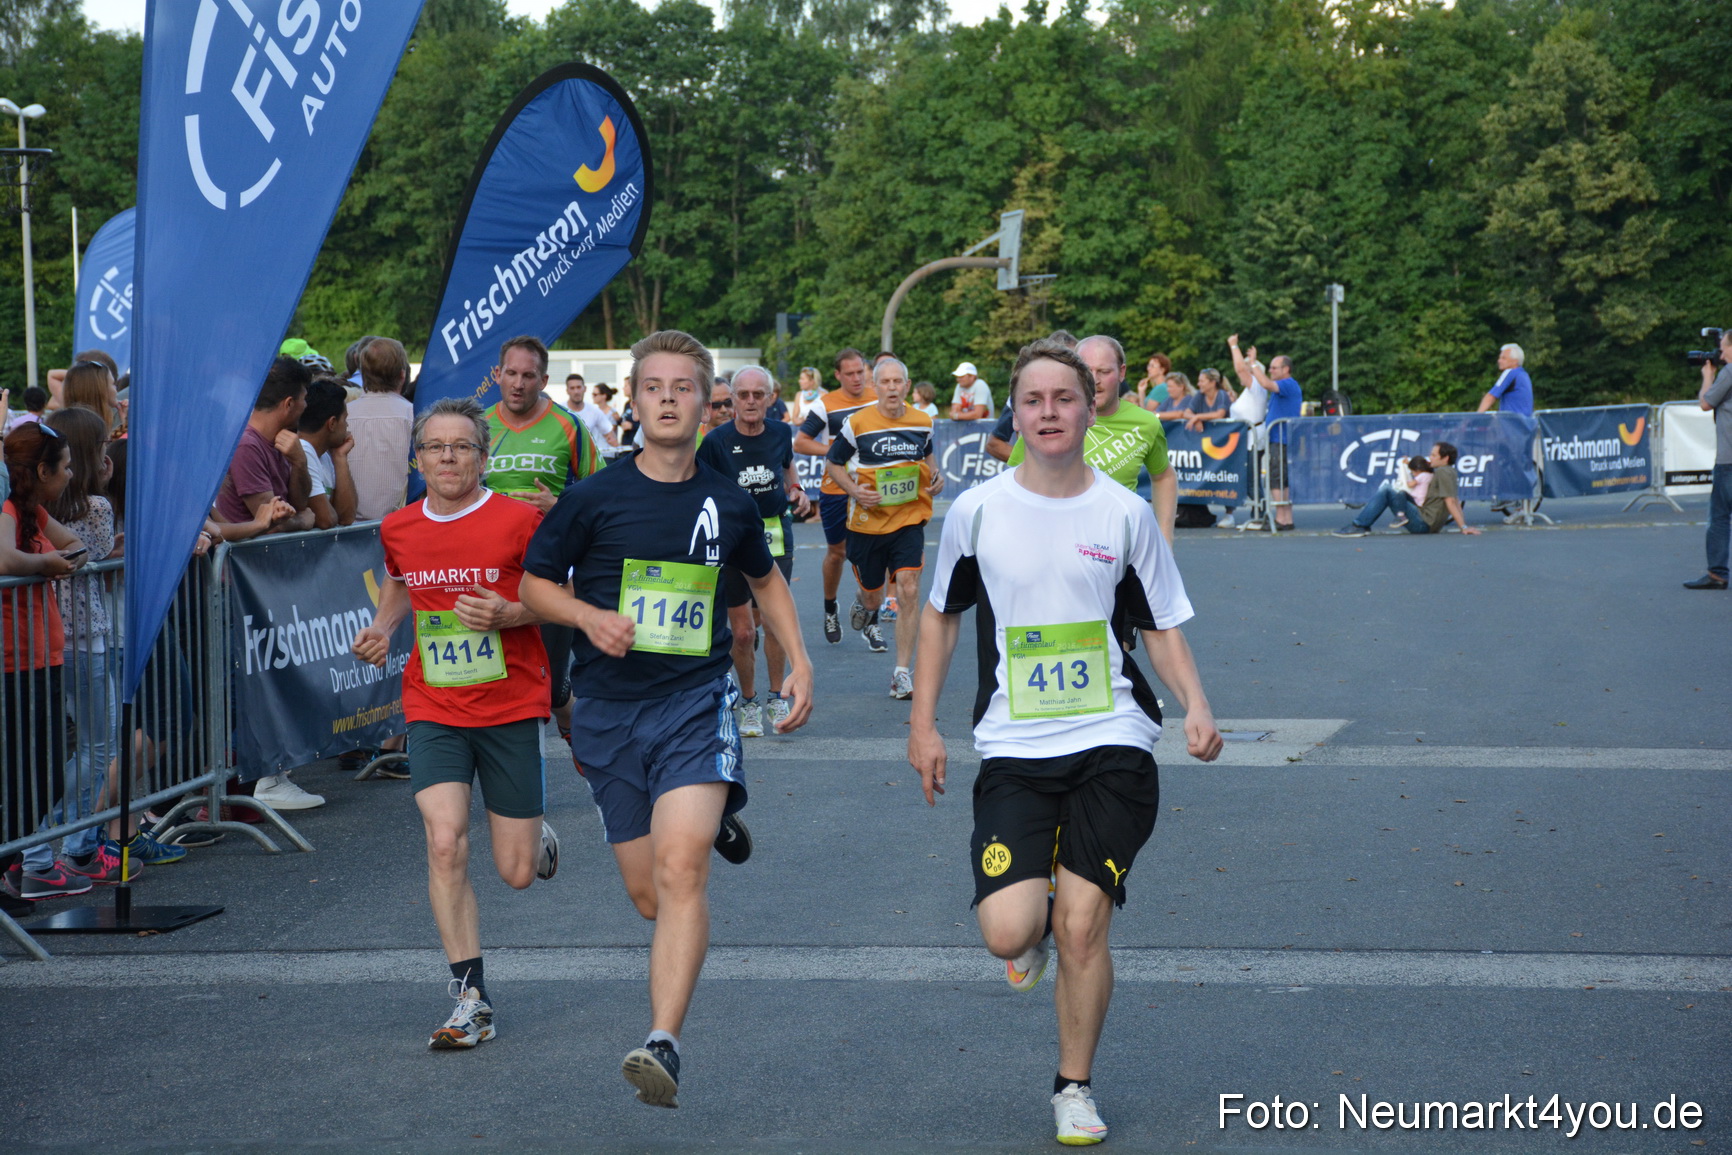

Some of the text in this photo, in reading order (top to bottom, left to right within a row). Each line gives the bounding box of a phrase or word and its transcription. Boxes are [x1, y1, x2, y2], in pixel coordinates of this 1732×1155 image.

[537, 182, 639, 297] Druck und Medien
[441, 200, 589, 365] Frischmann
[881, 442, 919, 454] Fischer
[1543, 435, 1621, 461] Frischmann
[1590, 456, 1646, 471] Druck und Medien
[881, 480, 915, 496] 1630
[1184, 470, 1202, 481] und
[1202, 470, 1239, 483] Medien
[1083, 549, 1117, 562] partner
[1093, 543, 1110, 551] TEAM
[631, 596, 705, 630] 1146
[428, 636, 495, 665] 1414
[330, 661, 362, 694] Druck
[1027, 660, 1090, 692] 413
[985, 847, 1007, 870] BVB
